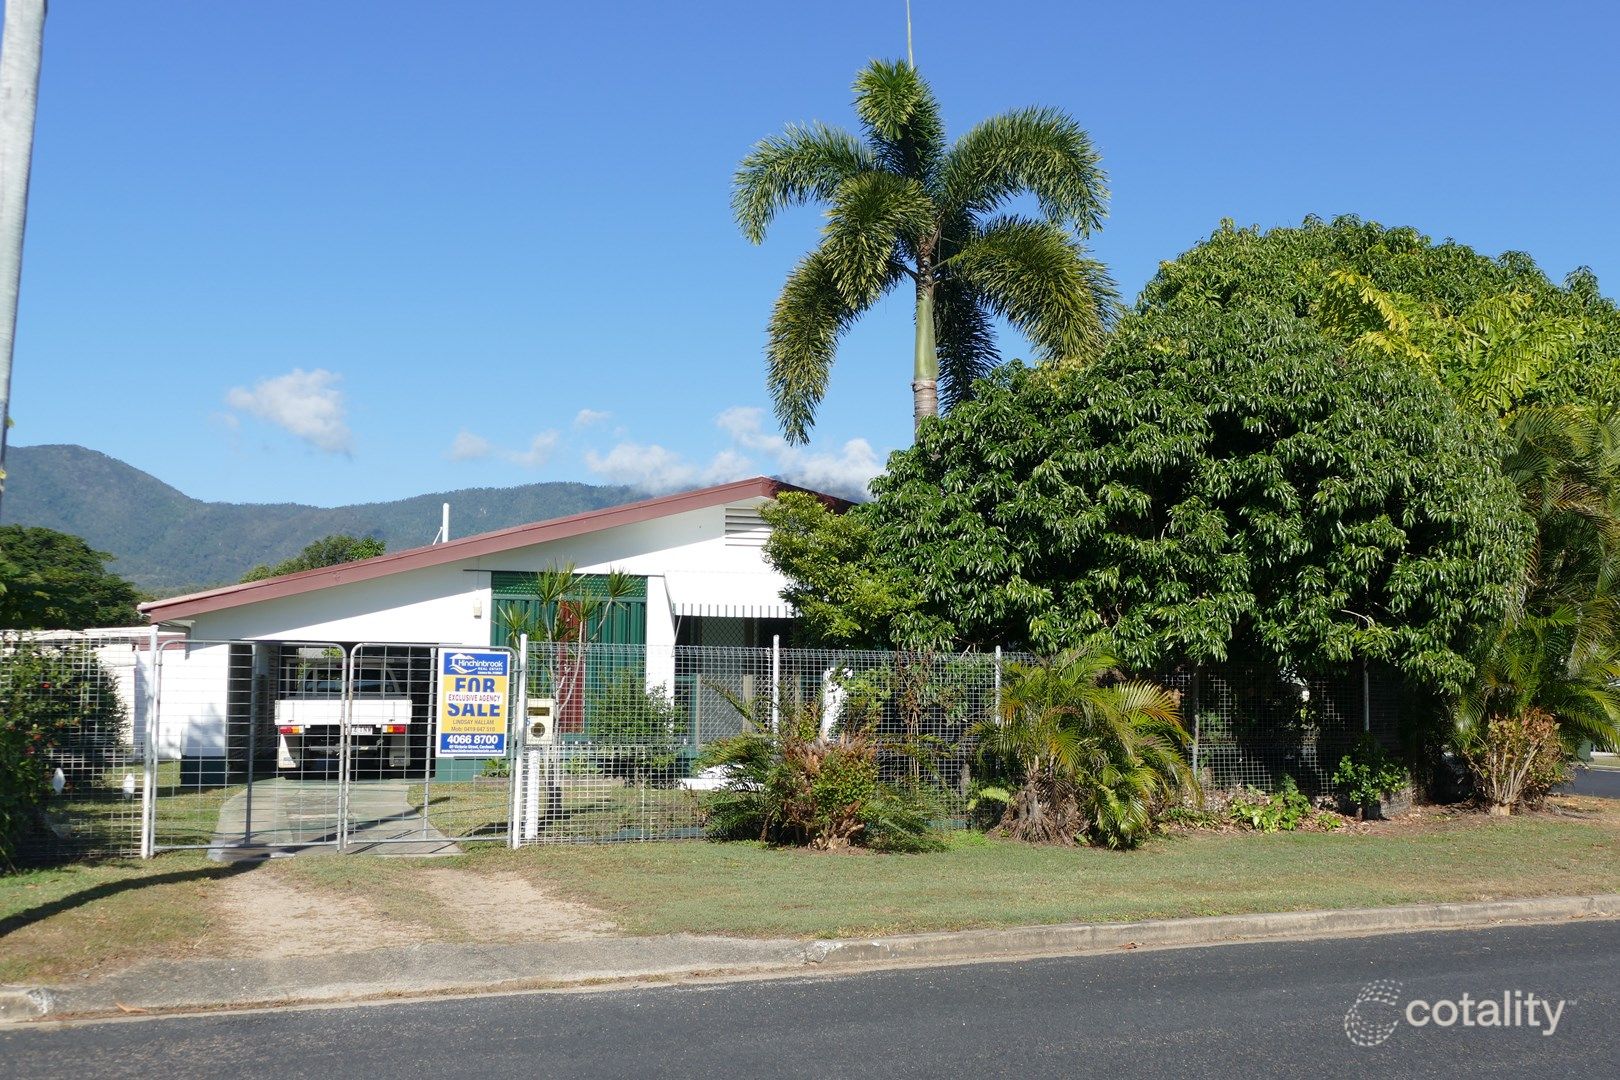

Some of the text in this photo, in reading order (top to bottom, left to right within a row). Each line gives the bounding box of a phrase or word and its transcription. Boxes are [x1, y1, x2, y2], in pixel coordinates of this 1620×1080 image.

[458, 659, 503, 667] Hinchinbrook
[455, 677, 495, 692] FOR
[479, 694, 501, 702] AGENCY
[447, 703, 500, 716] SALE
[447, 734, 498, 744] 4066 8700
